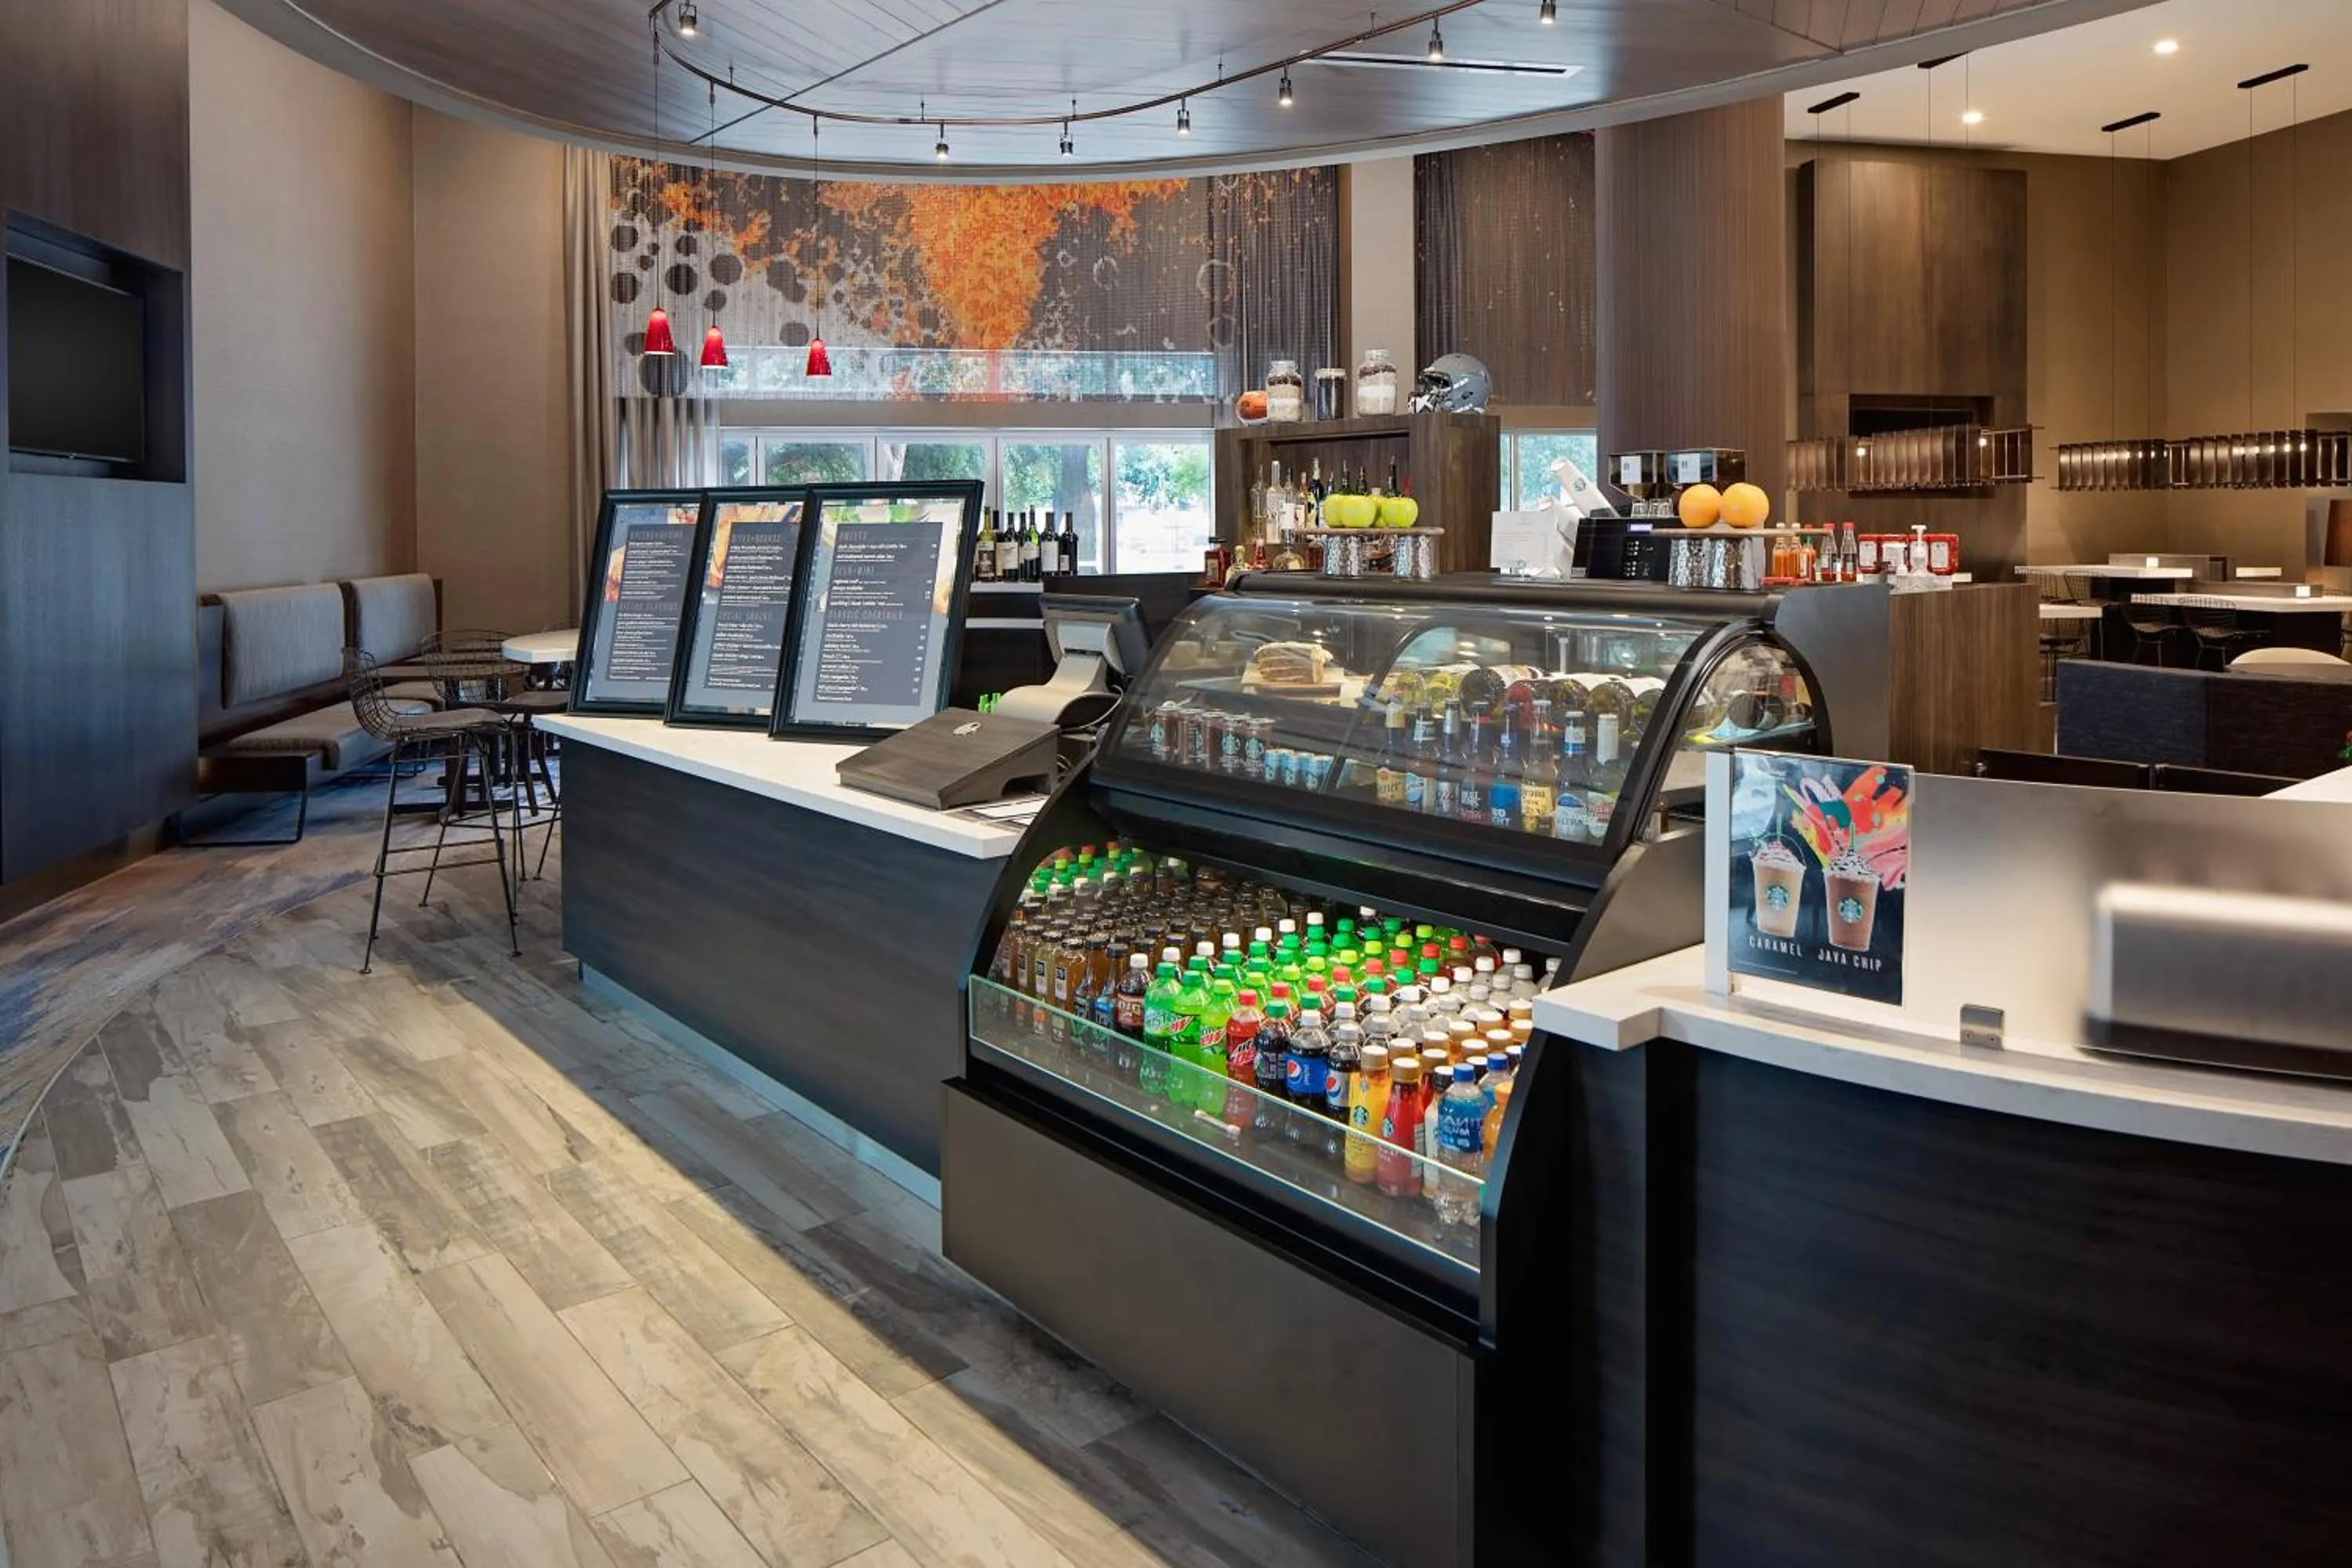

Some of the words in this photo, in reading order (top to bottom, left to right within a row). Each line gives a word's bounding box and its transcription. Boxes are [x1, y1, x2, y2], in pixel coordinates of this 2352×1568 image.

[1749, 935, 1802, 957] CARAMEL
[1818, 948, 1847, 965] JAVA
[1853, 954, 1882, 972] CHIP
